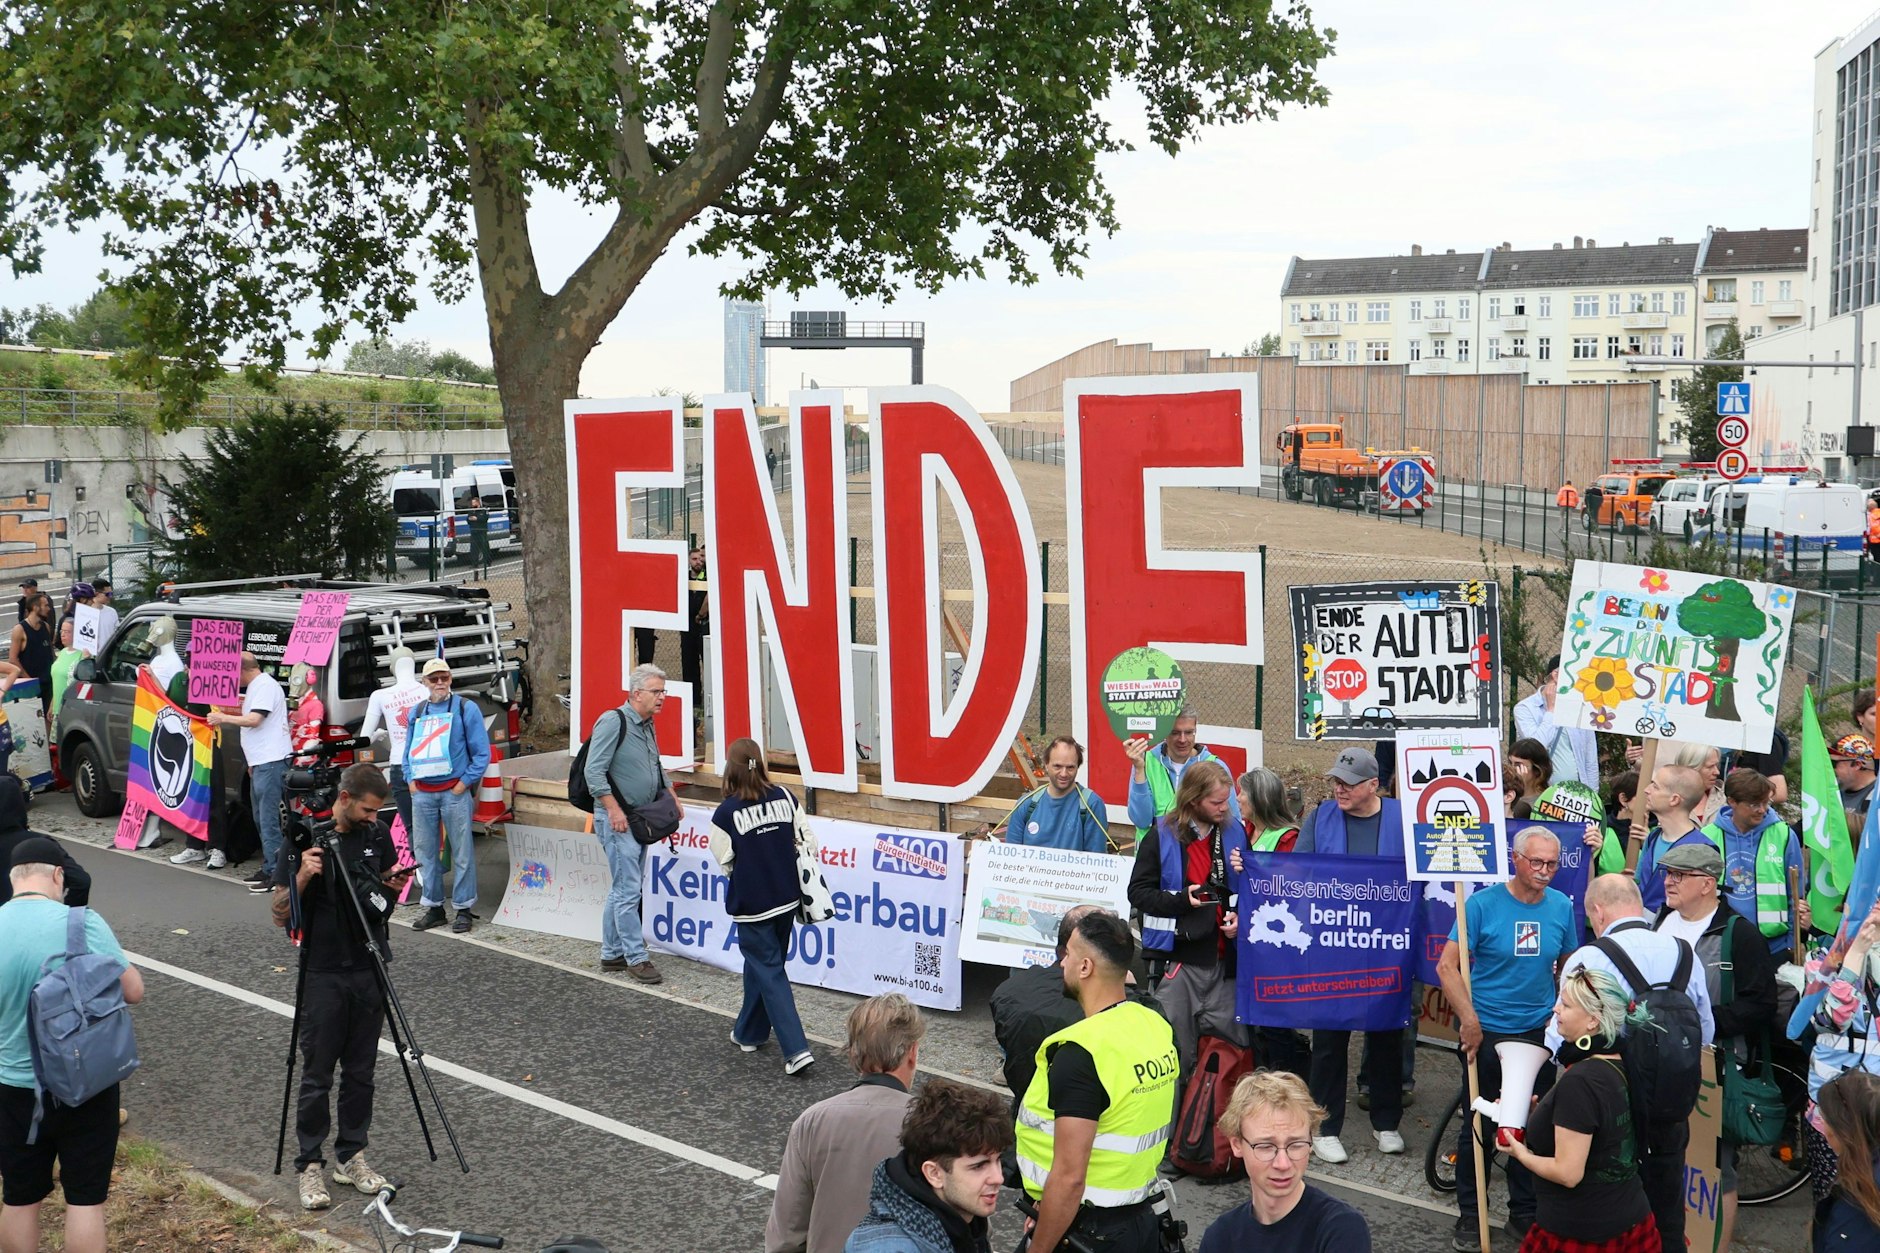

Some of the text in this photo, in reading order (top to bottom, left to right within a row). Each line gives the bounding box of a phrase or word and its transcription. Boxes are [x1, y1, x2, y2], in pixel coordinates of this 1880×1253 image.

[1725, 425, 1743, 438] 50
[304, 594, 349, 604] DAS ENDE
[564, 372, 1264, 823] ENDE
[1603, 596, 1669, 621] BEGINN
[314, 605, 333, 615] DER
[1316, 607, 1364, 628] ENDE
[196, 620, 242, 636] DAS ENDE
[293, 631, 333, 643] FREIHEIT
[1373, 607, 1469, 658] AUTO
[1636, 620, 1664, 632] DER
[194, 636, 242, 654] DROHNT
[1321, 632, 1362, 654] DER
[1594, 626, 1722, 672] ZUKUNFTS
[194, 660, 237, 672] IN UNSEREN
[191, 676, 238, 698] OHREN
[1152, 680, 1178, 688] WALD
[1326, 670, 1364, 690] STOP
[1378, 664, 1472, 706] STADT
[1634, 662, 1738, 707] STADT
[1108, 690, 1178, 700] STATT ASPHALT
[1554, 794, 1590, 814] STADT
[733, 798, 794, 836] OAKLAND
[1434, 815, 1480, 830] ENDE
[876, 836, 944, 877] A100
[878, 841, 946, 874] Bürgerinitiative
[988, 860, 1002, 868] Die
[993, 874, 1002, 882] ist
[1033, 878, 1053, 888] nicht
[1055, 882, 1084, 890] gebaut
[1086, 884, 1108, 894] wird!
[1250, 875, 1412, 902] volksentscheid
[831, 882, 946, 937] erbau
[1310, 903, 1372, 927] berlin
[654, 902, 713, 948] der
[1320, 928, 1410, 950] autofrei
[874, 972, 944, 994] www.bi-a100.de
[1262, 973, 1396, 998] jetzt unterschreiben!
